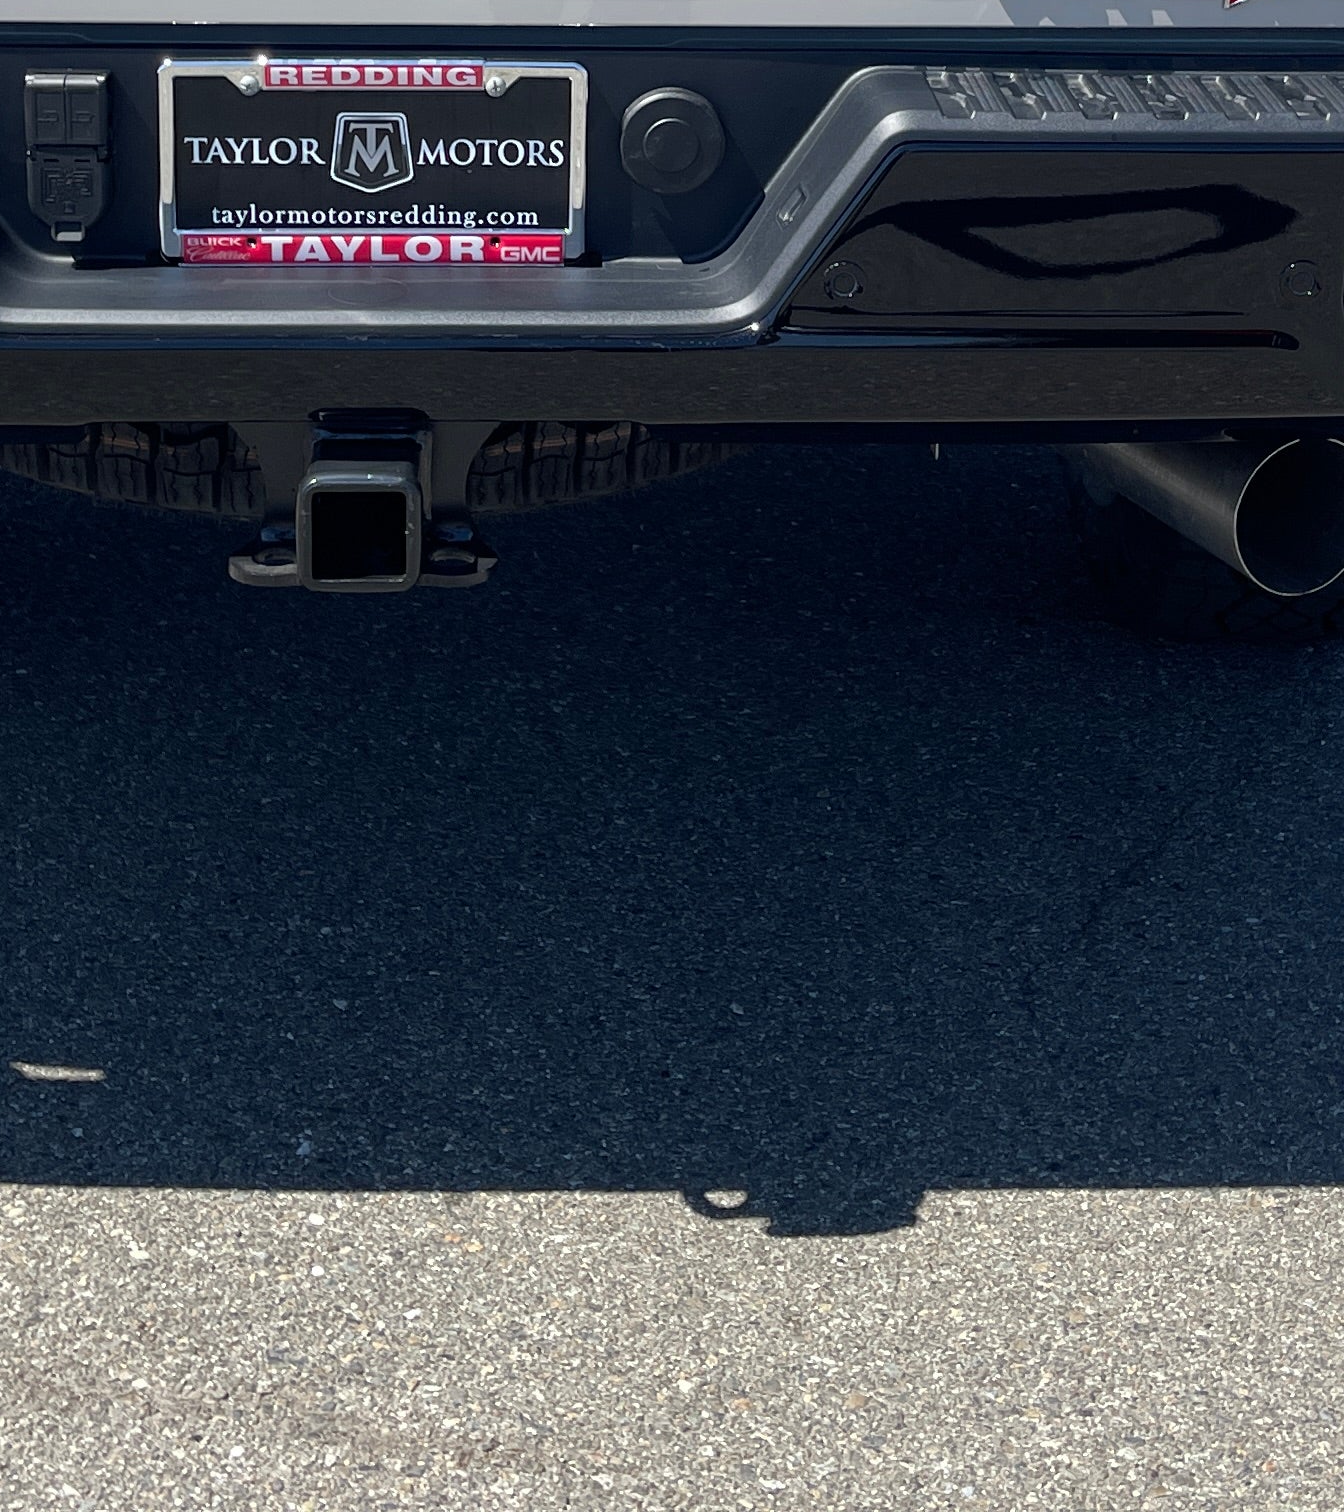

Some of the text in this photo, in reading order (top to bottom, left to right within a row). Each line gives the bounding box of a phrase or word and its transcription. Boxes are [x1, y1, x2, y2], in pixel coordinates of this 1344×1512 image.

[269, 66, 477, 87] REDDING
[183, 136, 326, 166] TAYLOR
[416, 138, 565, 168] MOTORS
[212, 203, 539, 228] taylormotorsredding.com
[187, 237, 243, 247] BUICK
[260, 235, 485, 263] TAYLOR
[500, 246, 561, 262] GMC
